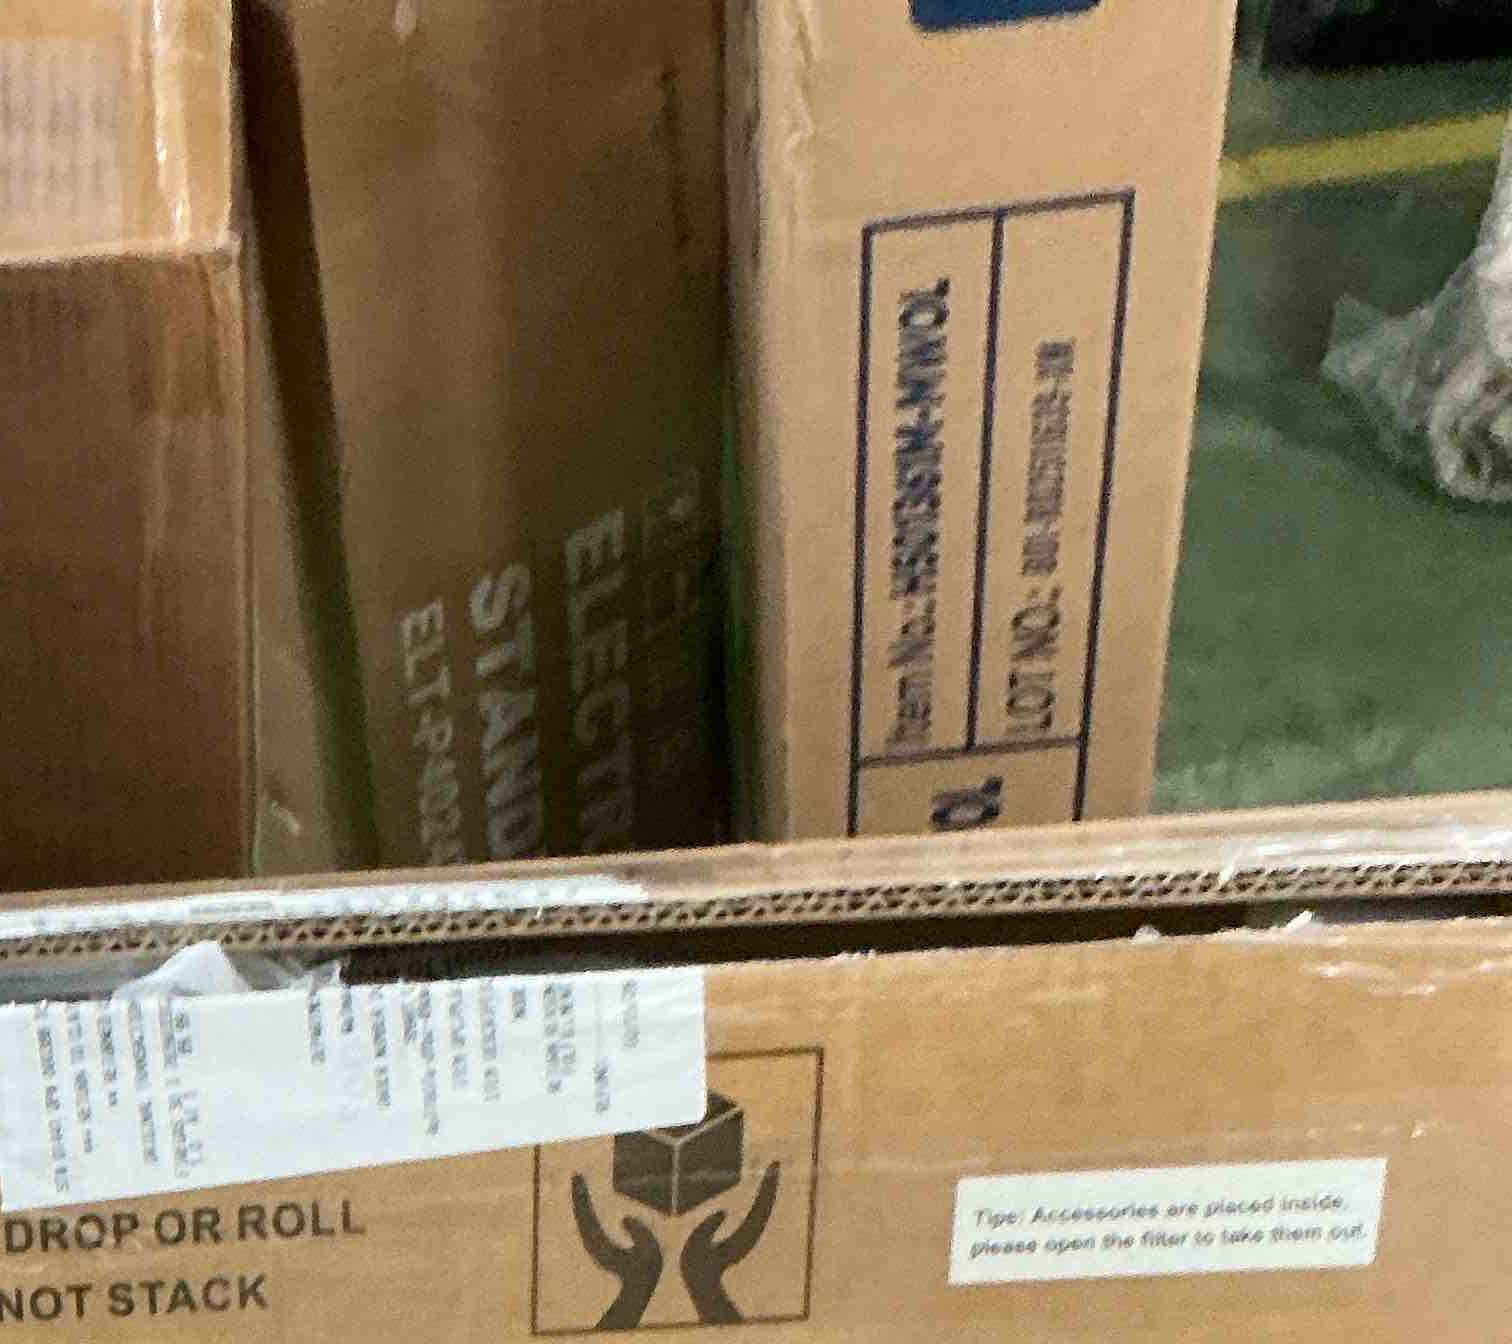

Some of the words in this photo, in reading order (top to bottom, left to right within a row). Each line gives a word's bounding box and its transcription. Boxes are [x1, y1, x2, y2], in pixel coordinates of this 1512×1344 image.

[5, 1213, 141, 1256] DROP
[154, 1207, 223, 1247] OR
[237, 1198, 368, 1242] ROLL
[1031, 1203, 1159, 1224] Accessories
[1166, 1201, 1199, 1217] are
[1205, 1195, 1275, 1219] placed
[968, 1236, 1037, 1260] please
[1044, 1235, 1095, 1257] open
[1103, 1230, 1135, 1250] the
[1141, 1228, 1187, 1248] filter
[1221, 1226, 1263, 1246] take
[1271, 1224, 1321, 1243] them
[106, 1275, 268, 1318] STACK
